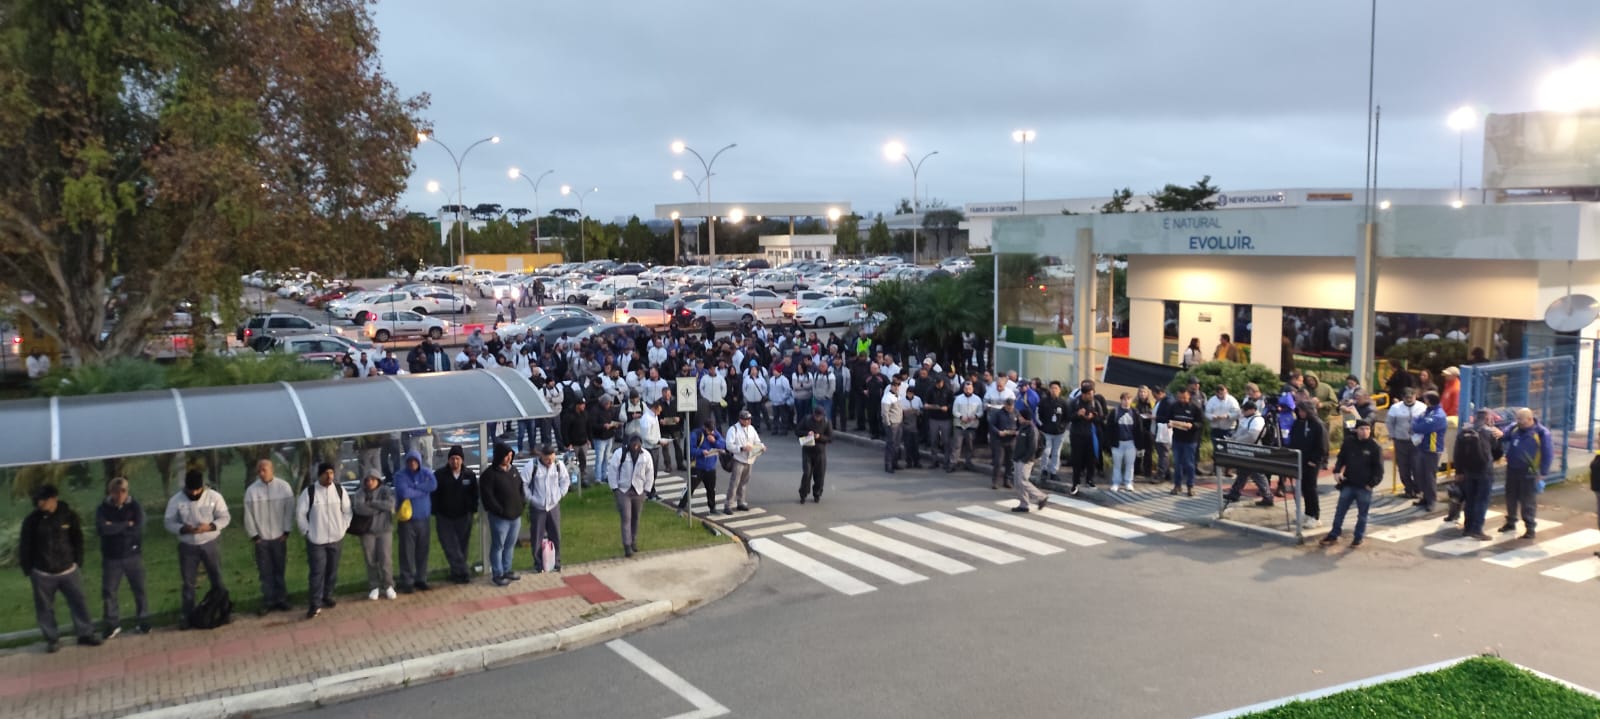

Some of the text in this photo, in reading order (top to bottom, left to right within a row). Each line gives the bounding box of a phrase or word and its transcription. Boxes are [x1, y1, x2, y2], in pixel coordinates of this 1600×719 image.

[1228, 194, 1284, 204] NEW HOLLAND
[1172, 217, 1222, 229] NATURAL
